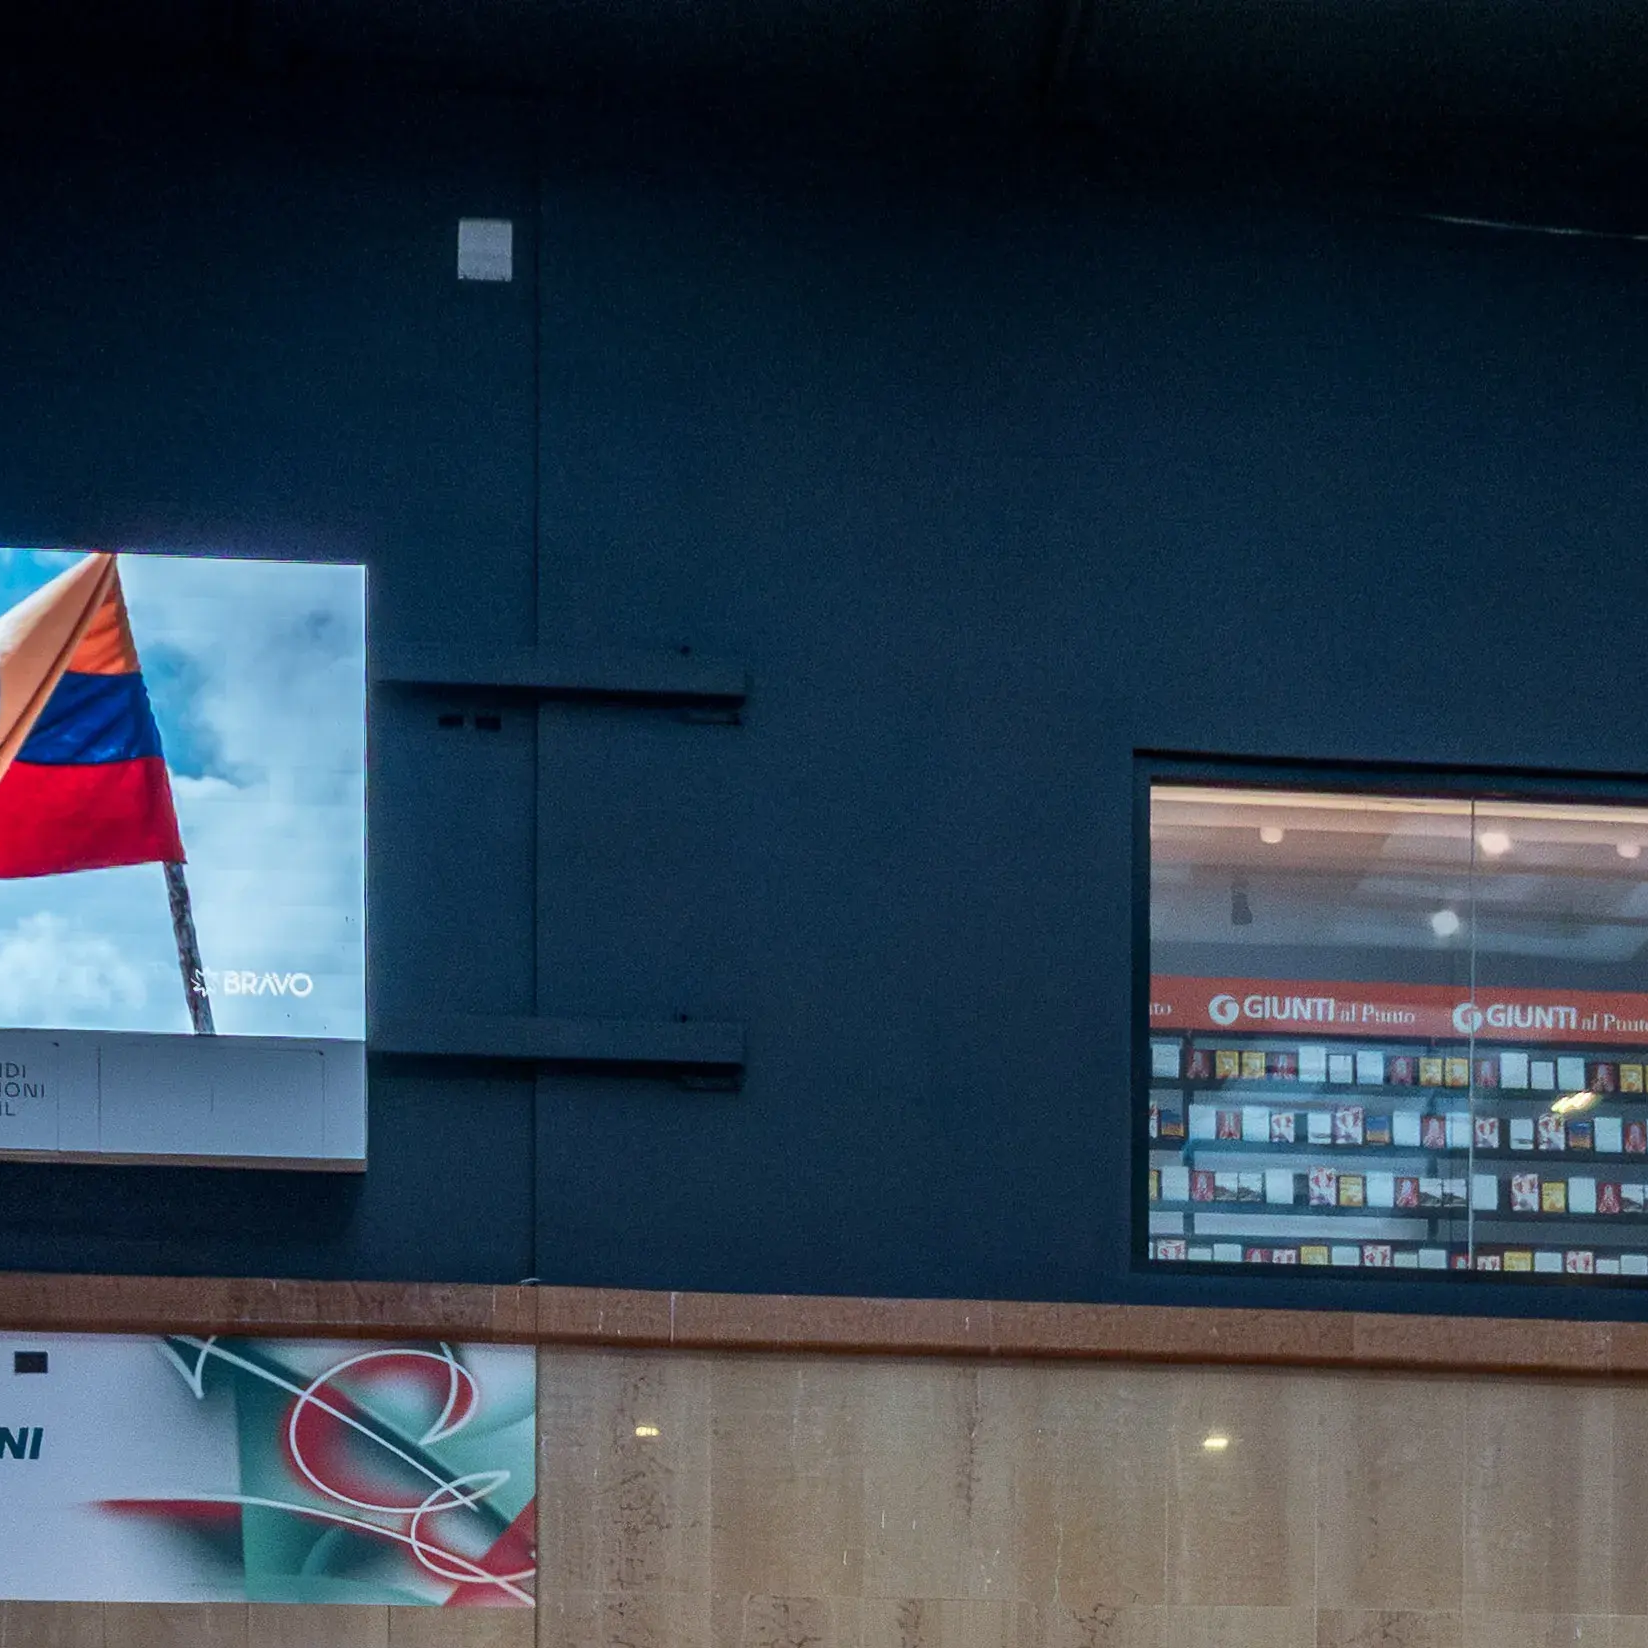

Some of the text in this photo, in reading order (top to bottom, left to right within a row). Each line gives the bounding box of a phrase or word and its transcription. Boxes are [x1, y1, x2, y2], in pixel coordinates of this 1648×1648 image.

[223, 972, 314, 997] BRAVO
[1243, 994, 1335, 1023] GIUNTI
[1361, 1007, 1416, 1025] Punto
[1486, 1003, 1579, 1030] GIUNTI
